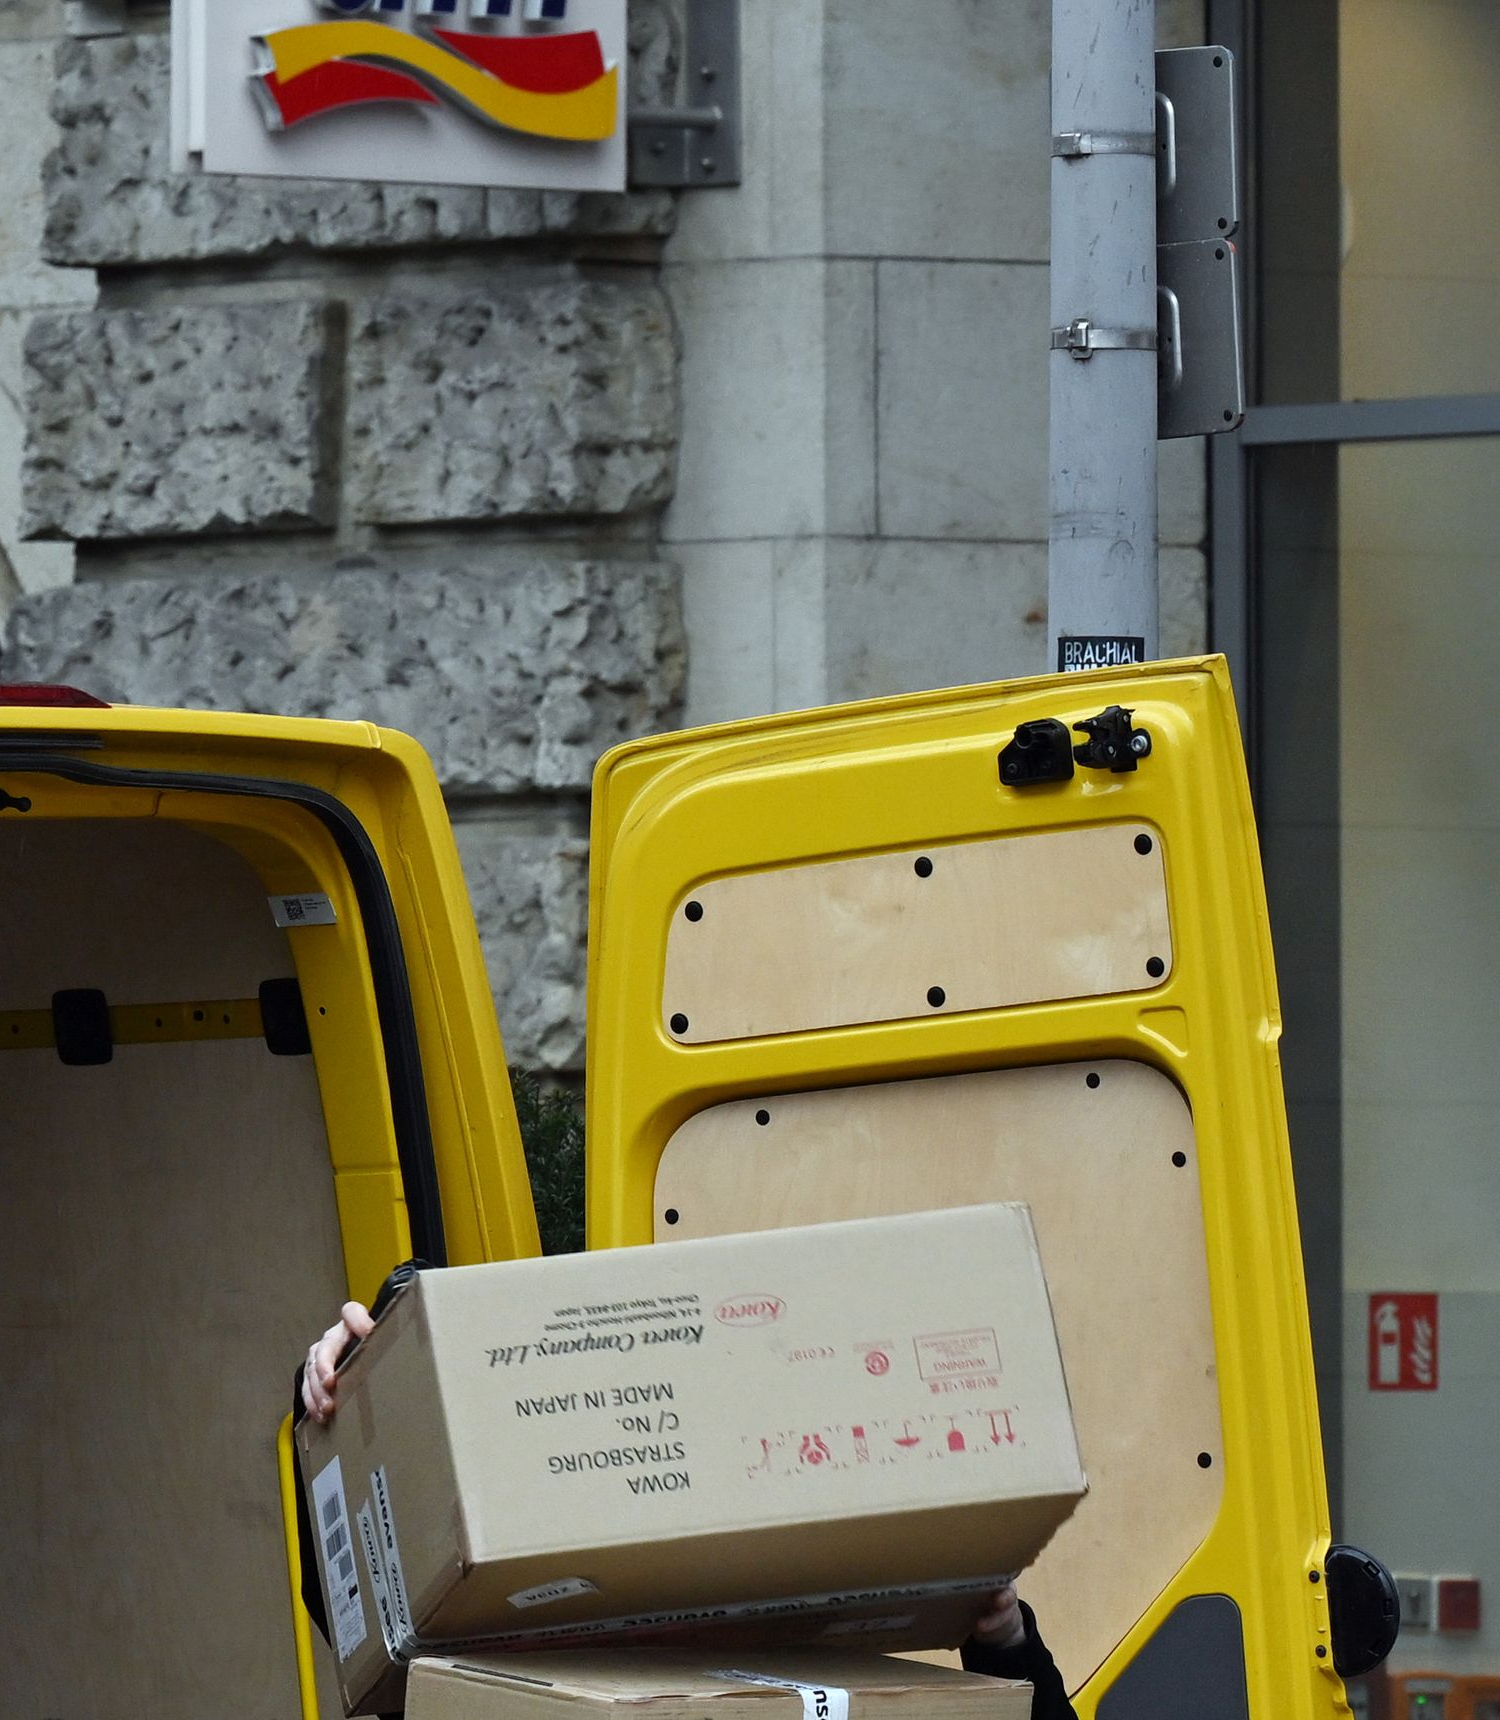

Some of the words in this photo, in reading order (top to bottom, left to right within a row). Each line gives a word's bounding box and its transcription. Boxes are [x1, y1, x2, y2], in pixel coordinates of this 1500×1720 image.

[642, 1323, 705, 1345] Kowa
[515, 1392, 577, 1418] JAPAN
[585, 1389, 607, 1408] IN
[612, 1382, 675, 1406] MADE
[616, 1414, 651, 1433] No.
[658, 1410, 680, 1433] C/
[548, 1440, 686, 1474] STRASBOURG
[626, 1470, 691, 1496] KOWA
